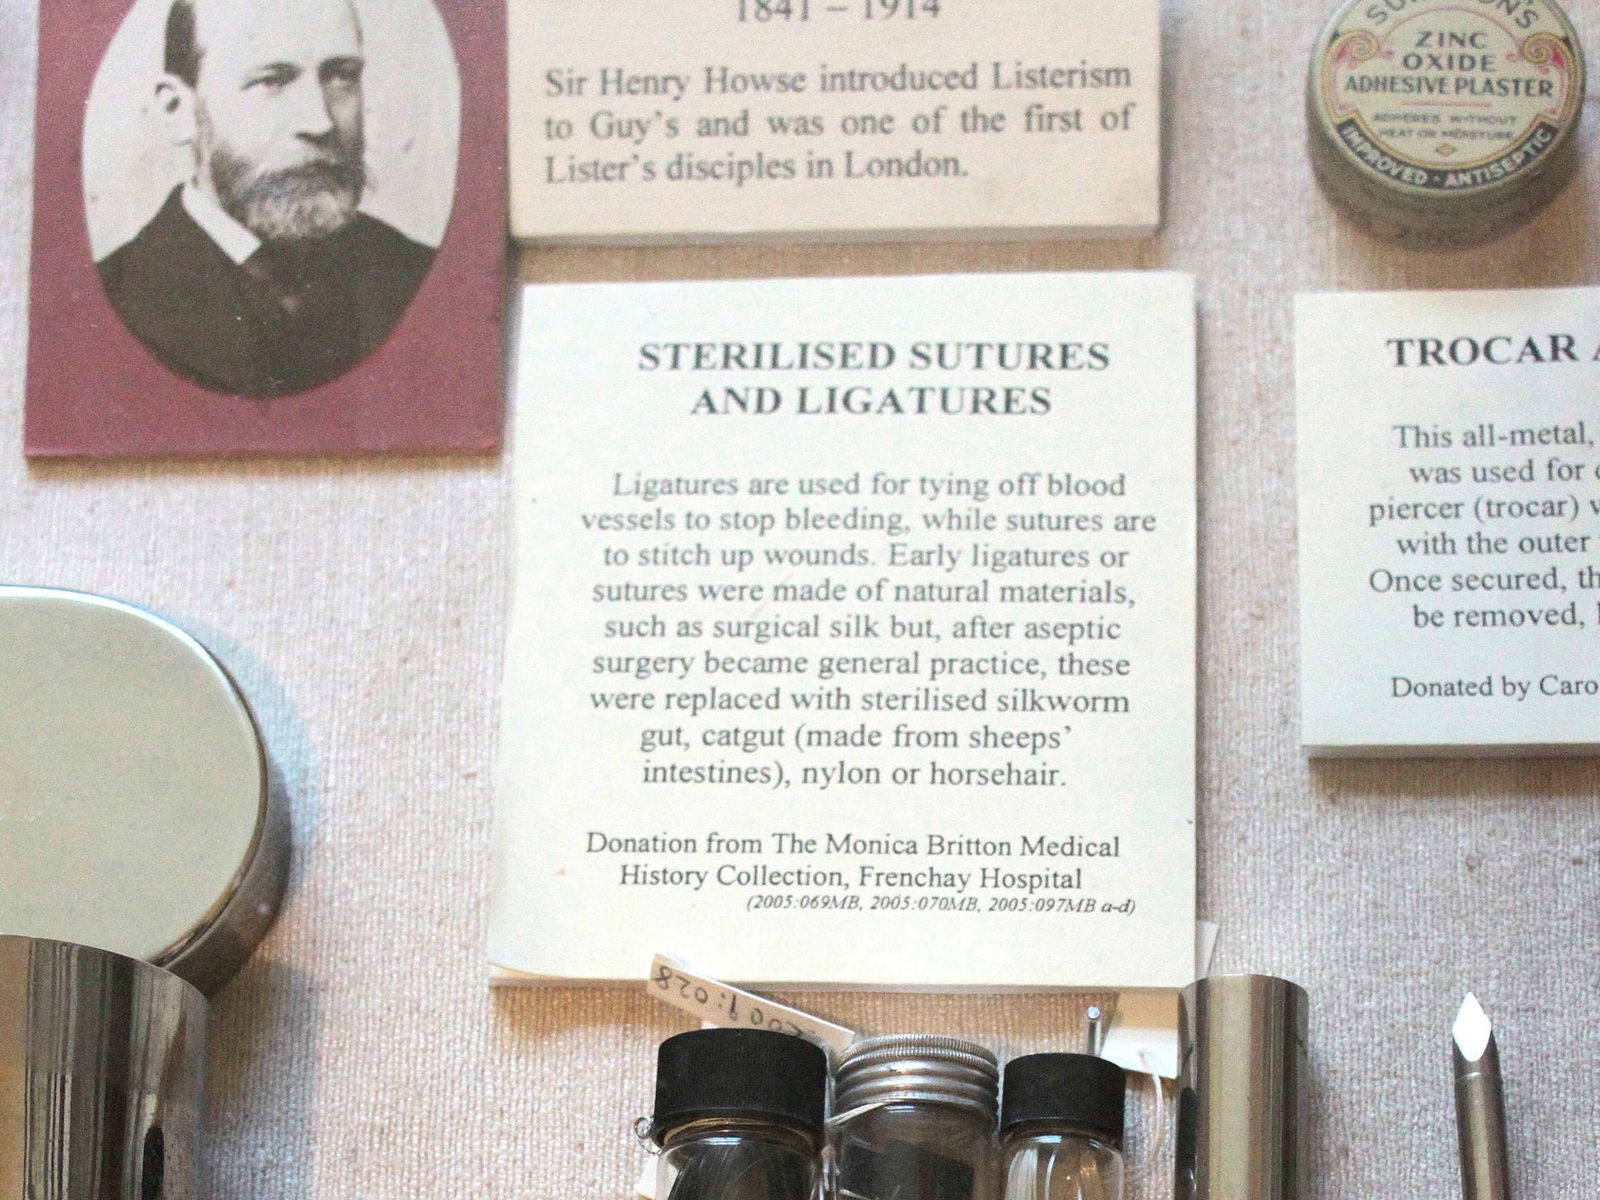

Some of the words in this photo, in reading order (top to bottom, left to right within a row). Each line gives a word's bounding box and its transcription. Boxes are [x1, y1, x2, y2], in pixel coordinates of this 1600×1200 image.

[738, 0, 809, 22] 1841
[864, 0, 941, 20] 1914
[1415, 31, 1488, 49] ZINC
[1402, 53, 1497, 73] OXIDE
[545, 67, 588, 97] Sir
[600, 67, 690, 100] Henry
[704, 65, 807, 94] Howse
[820, 61, 978, 92] introduced
[992, 60, 1131, 89] Listerism
[1345, 75, 1448, 96] ADHESIVE
[1455, 77, 1554, 98] PLASTER
[544, 116, 573, 140] to
[589, 110, 679, 145] Guy’s
[696, 108, 749, 137] and
[766, 114, 824, 136] was
[840, 113, 894, 135] one
[911, 104, 947, 134] of
[960, 104, 1006, 134] the
[1024, 102, 1083, 133] first
[1100, 101, 1136, 131] of
[545, 153, 657, 184] Lister’s
[665, 151, 796, 188] disciples
[807, 150, 834, 179] in
[844, 148, 968, 179] London.
[1342, 125, 1429, 186] IMPROVED
[1445, 128, 1552, 187] ANTISEPTIC
[639, 342, 896, 370] STERILISED
[910, 342, 1109, 370] SUTURES
[1386, 334, 1578, 366] TROCAR
[691, 387, 782, 414] AND
[797, 387, 1051, 414] LIGATURES
[1392, 425, 1452, 448] This
[1462, 421, 1594, 448] all-metal,
[1409, 467, 1461, 484] was
[1472, 459, 1535, 483] used
[1547, 457, 1585, 481] for
[613, 472, 739, 501] Ligatures
[748, 478, 789, 495] are
[799, 472, 860, 495] used
[872, 471, 911, 495] for
[919, 472, 989, 502] tying
[998, 472, 1042, 496] off
[1047, 473, 1125, 496] blood
[581, 508, 675, 531] vessels
[685, 511, 711, 530] to
[720, 511, 775, 537] stop
[785, 507, 910, 536] bleeding,
[922, 508, 997, 531] while
[1006, 512, 1103, 532] sutures
[1114, 515, 1156, 532] are
[1369, 496, 1465, 527] piercer
[1474, 495, 1579, 523] (trocar)
[604, 547, 629, 566] to
[638, 543, 710, 566] stitch
[721, 549, 754, 572] up
[764, 543, 875, 566] wounds.
[888, 543, 961, 572] Early
[972, 543, 1090, 573] ligatures
[1100, 551, 1130, 568] or
[1396, 532, 1457, 555] with
[1466, 531, 1508, 554] the
[1518, 533, 1591, 554] outer
[593, 582, 688, 602] sutures
[698, 584, 764, 602] were
[773, 578, 847, 602] made
[856, 578, 889, 602] of
[894, 579, 988, 602] natural
[1000, 580, 1135, 608] materials,
[1369, 569, 1442, 593] Once
[1452, 566, 1567, 593] secured,
[605, 614, 666, 638] such
[676, 620, 703, 638] as
[713, 614, 819, 644] surgical
[830, 614, 879, 638] silk
[890, 614, 941, 642] but,
[952, 615, 1015, 639] after
[1024, 616, 1121, 646] aseptic
[1413, 604, 1444, 628] be
[1454, 601, 1585, 629] removed,
[593, 656, 695, 680] surgery
[705, 650, 808, 674] became
[818, 651, 919, 680] general
[930, 651, 1046, 681] practice,
[1058, 652, 1130, 676] these
[590, 693, 655, 710] were
[665, 686, 780, 717] replaced
[790, 687, 850, 710] with
[861, 687, 987, 711] sterilised
[997, 688, 1129, 713] silkworm
[1391, 675, 1493, 697] Donated
[1501, 675, 1531, 702] by
[1539, 674, 1600, 696] Caro
[640, 727, 690, 753] gut,
[702, 727, 785, 753] catgut
[795, 723, 882, 752] (made
[893, 723, 958, 748] from
[969, 724, 1071, 755] sheeps’
[643, 759, 790, 789] intestines),
[802, 760, 880, 790] nylon
[892, 767, 921, 785] or
[930, 761, 1066, 786] horsehair.
[586, 831, 697, 853] Donation
[706, 831, 762, 854] from
[771, 832, 817, 854] The
[825, 833, 918, 855] Monica
[927, 834, 1011, 856] Britton
[1020, 835, 1119, 857] Medical
[620, 864, 708, 891] History
[716, 864, 849, 890] Collection,
[859, 866, 971, 893] Frenchay
[980, 867, 1081, 894] Hospital
